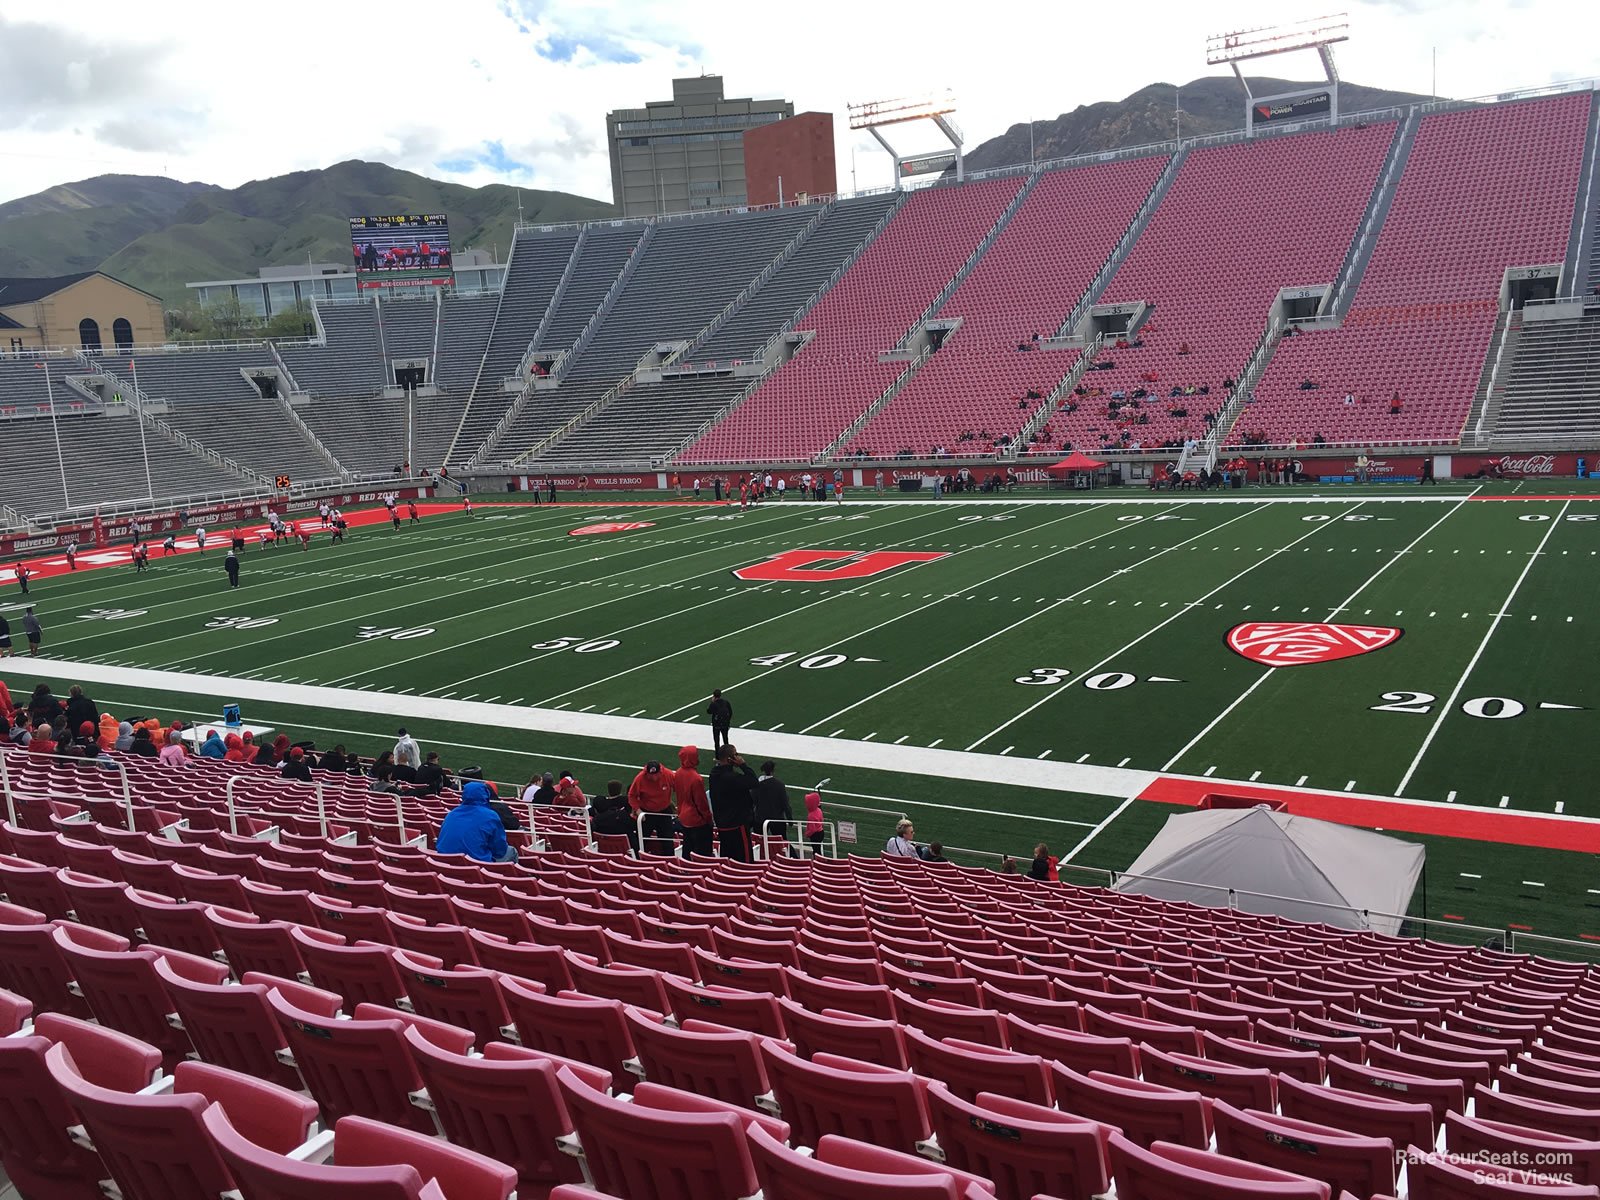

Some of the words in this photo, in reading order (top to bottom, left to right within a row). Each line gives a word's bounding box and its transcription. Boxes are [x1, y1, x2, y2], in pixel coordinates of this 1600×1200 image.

[1527, 269, 1541, 279] 37
[1111, 306, 1122, 314] 35
[277, 476, 289, 487] 25
[619, 477, 642, 485] FARGO
[359, 493, 376, 502] RED
[187, 513, 219, 524] niversity
[109, 527, 127, 537] RED
[128, 523, 153, 535] ZNE
[14, 536, 59, 549] University
[204, 616, 280, 629] 30
[355, 626, 435, 640] 40
[531, 637, 621, 653] 50
[748, 652, 848, 670] 40
[1014, 668, 1137, 691] 30
[1367, 691, 1526, 719] 20
